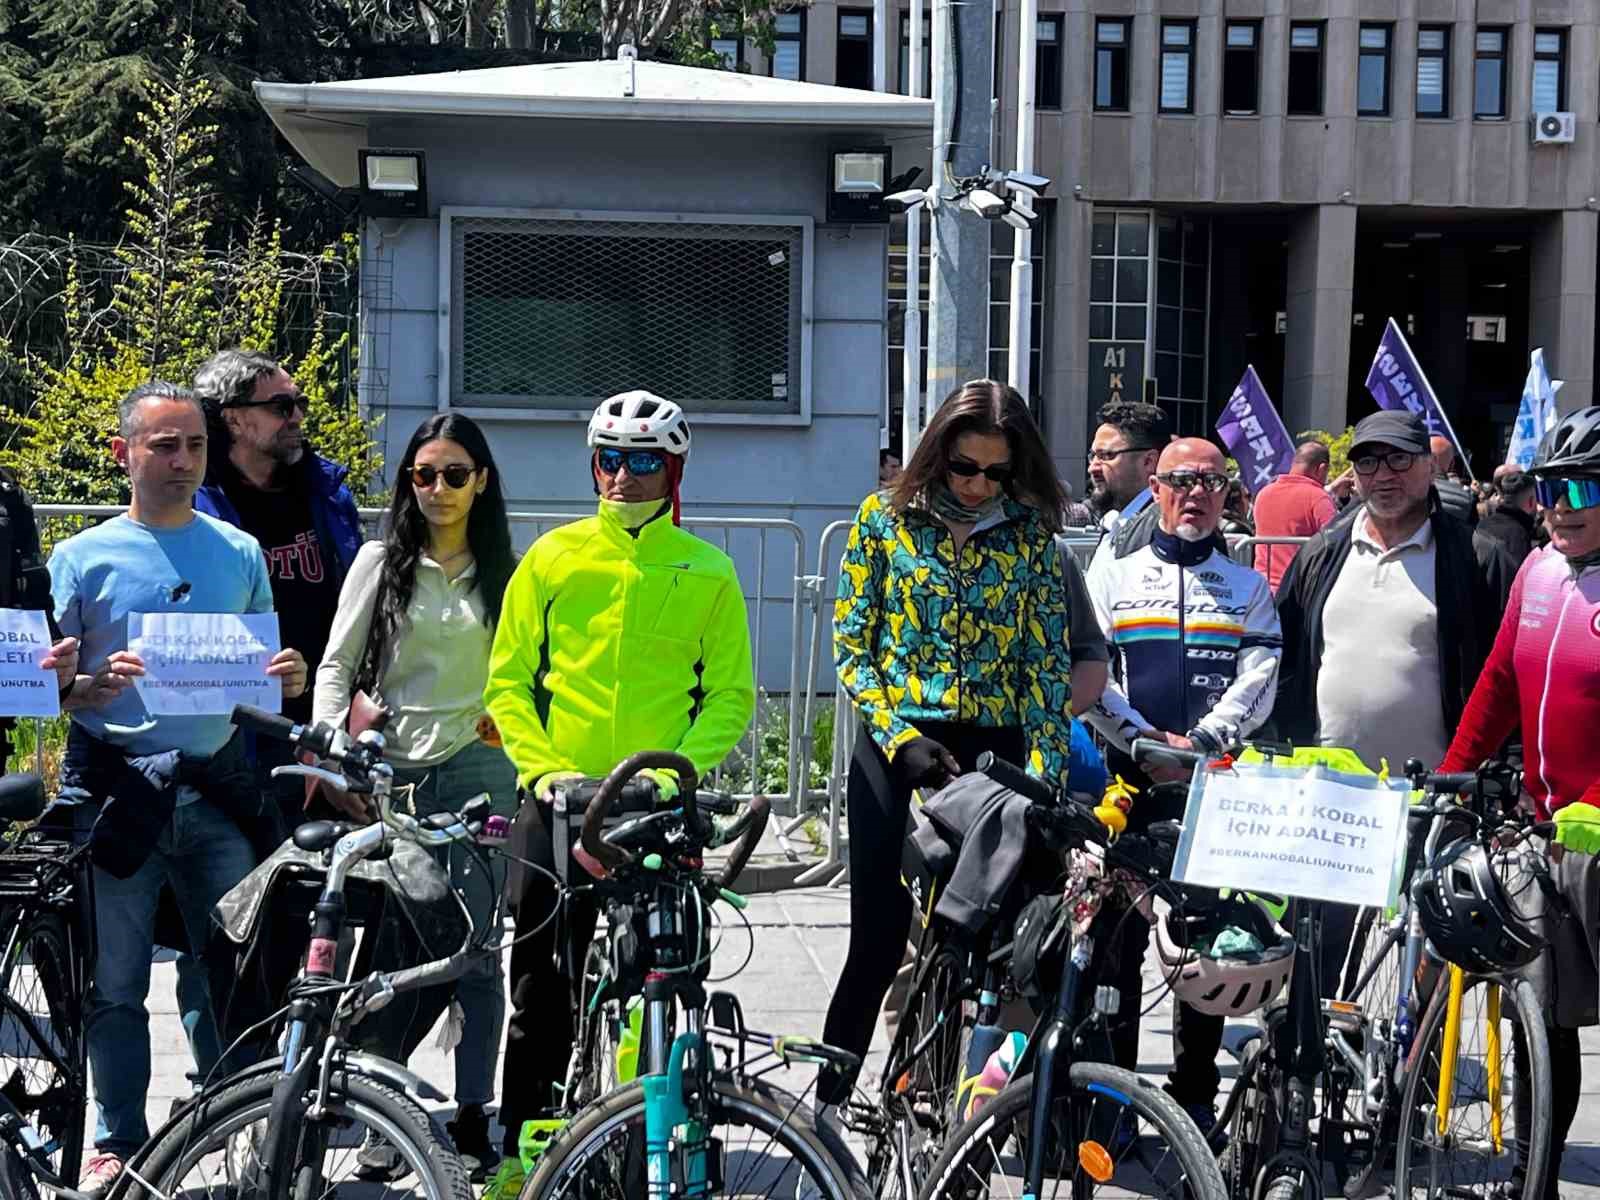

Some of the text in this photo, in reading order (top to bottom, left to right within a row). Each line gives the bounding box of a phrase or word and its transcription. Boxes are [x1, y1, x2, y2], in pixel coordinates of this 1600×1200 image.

[1103, 347, 1126, 368] A1
[1311, 804, 1383, 830] KOBAL
[1227, 818, 1367, 849] İÇİN ADALET!
